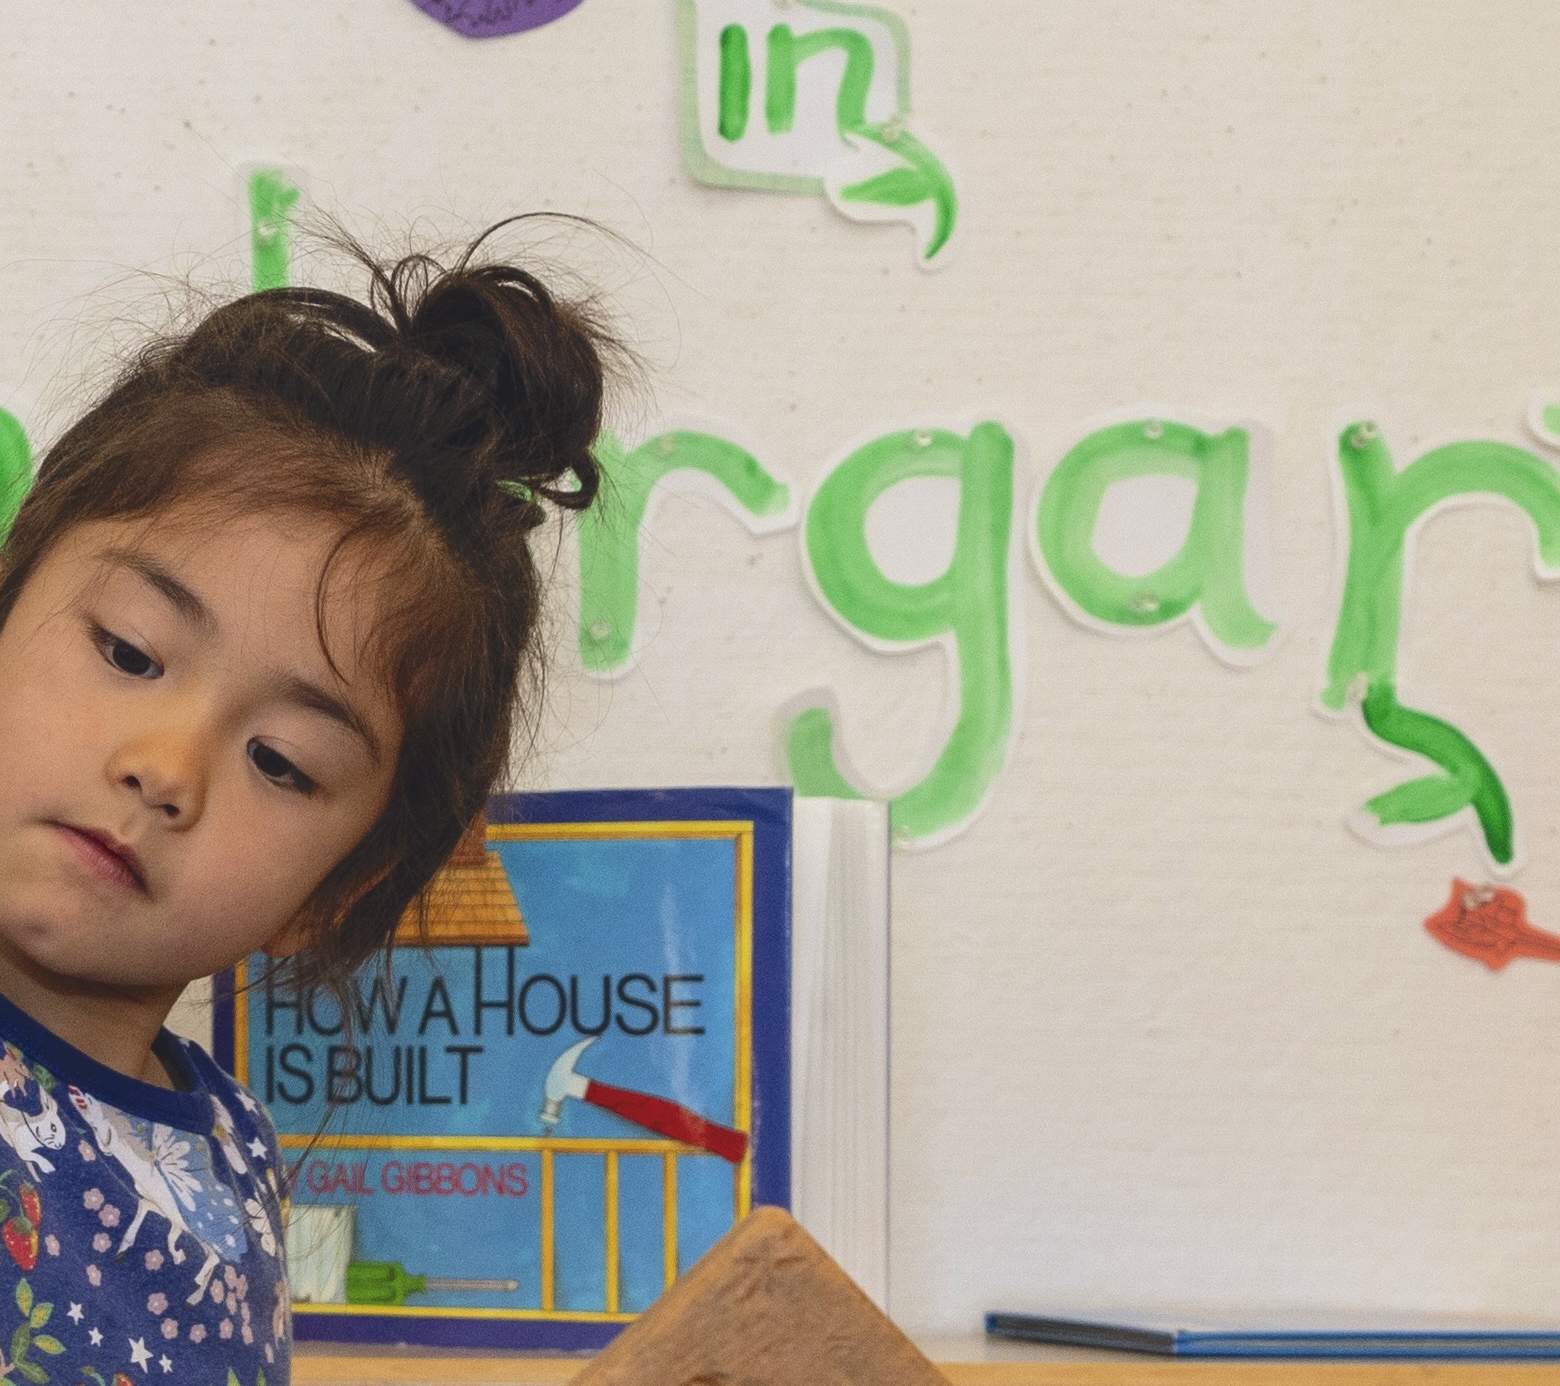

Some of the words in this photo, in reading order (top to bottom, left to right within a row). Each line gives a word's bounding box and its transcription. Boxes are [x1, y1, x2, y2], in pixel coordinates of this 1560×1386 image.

[265, 956, 408, 1036] HOW
[418, 975, 460, 1036] A
[474, 945, 705, 1037] HOUSE
[265, 1043, 315, 1105] IS
[327, 1045, 484, 1106] BUILT
[307, 1160, 376, 1196] GAIL
[383, 1160, 529, 1198] GIBBONS
